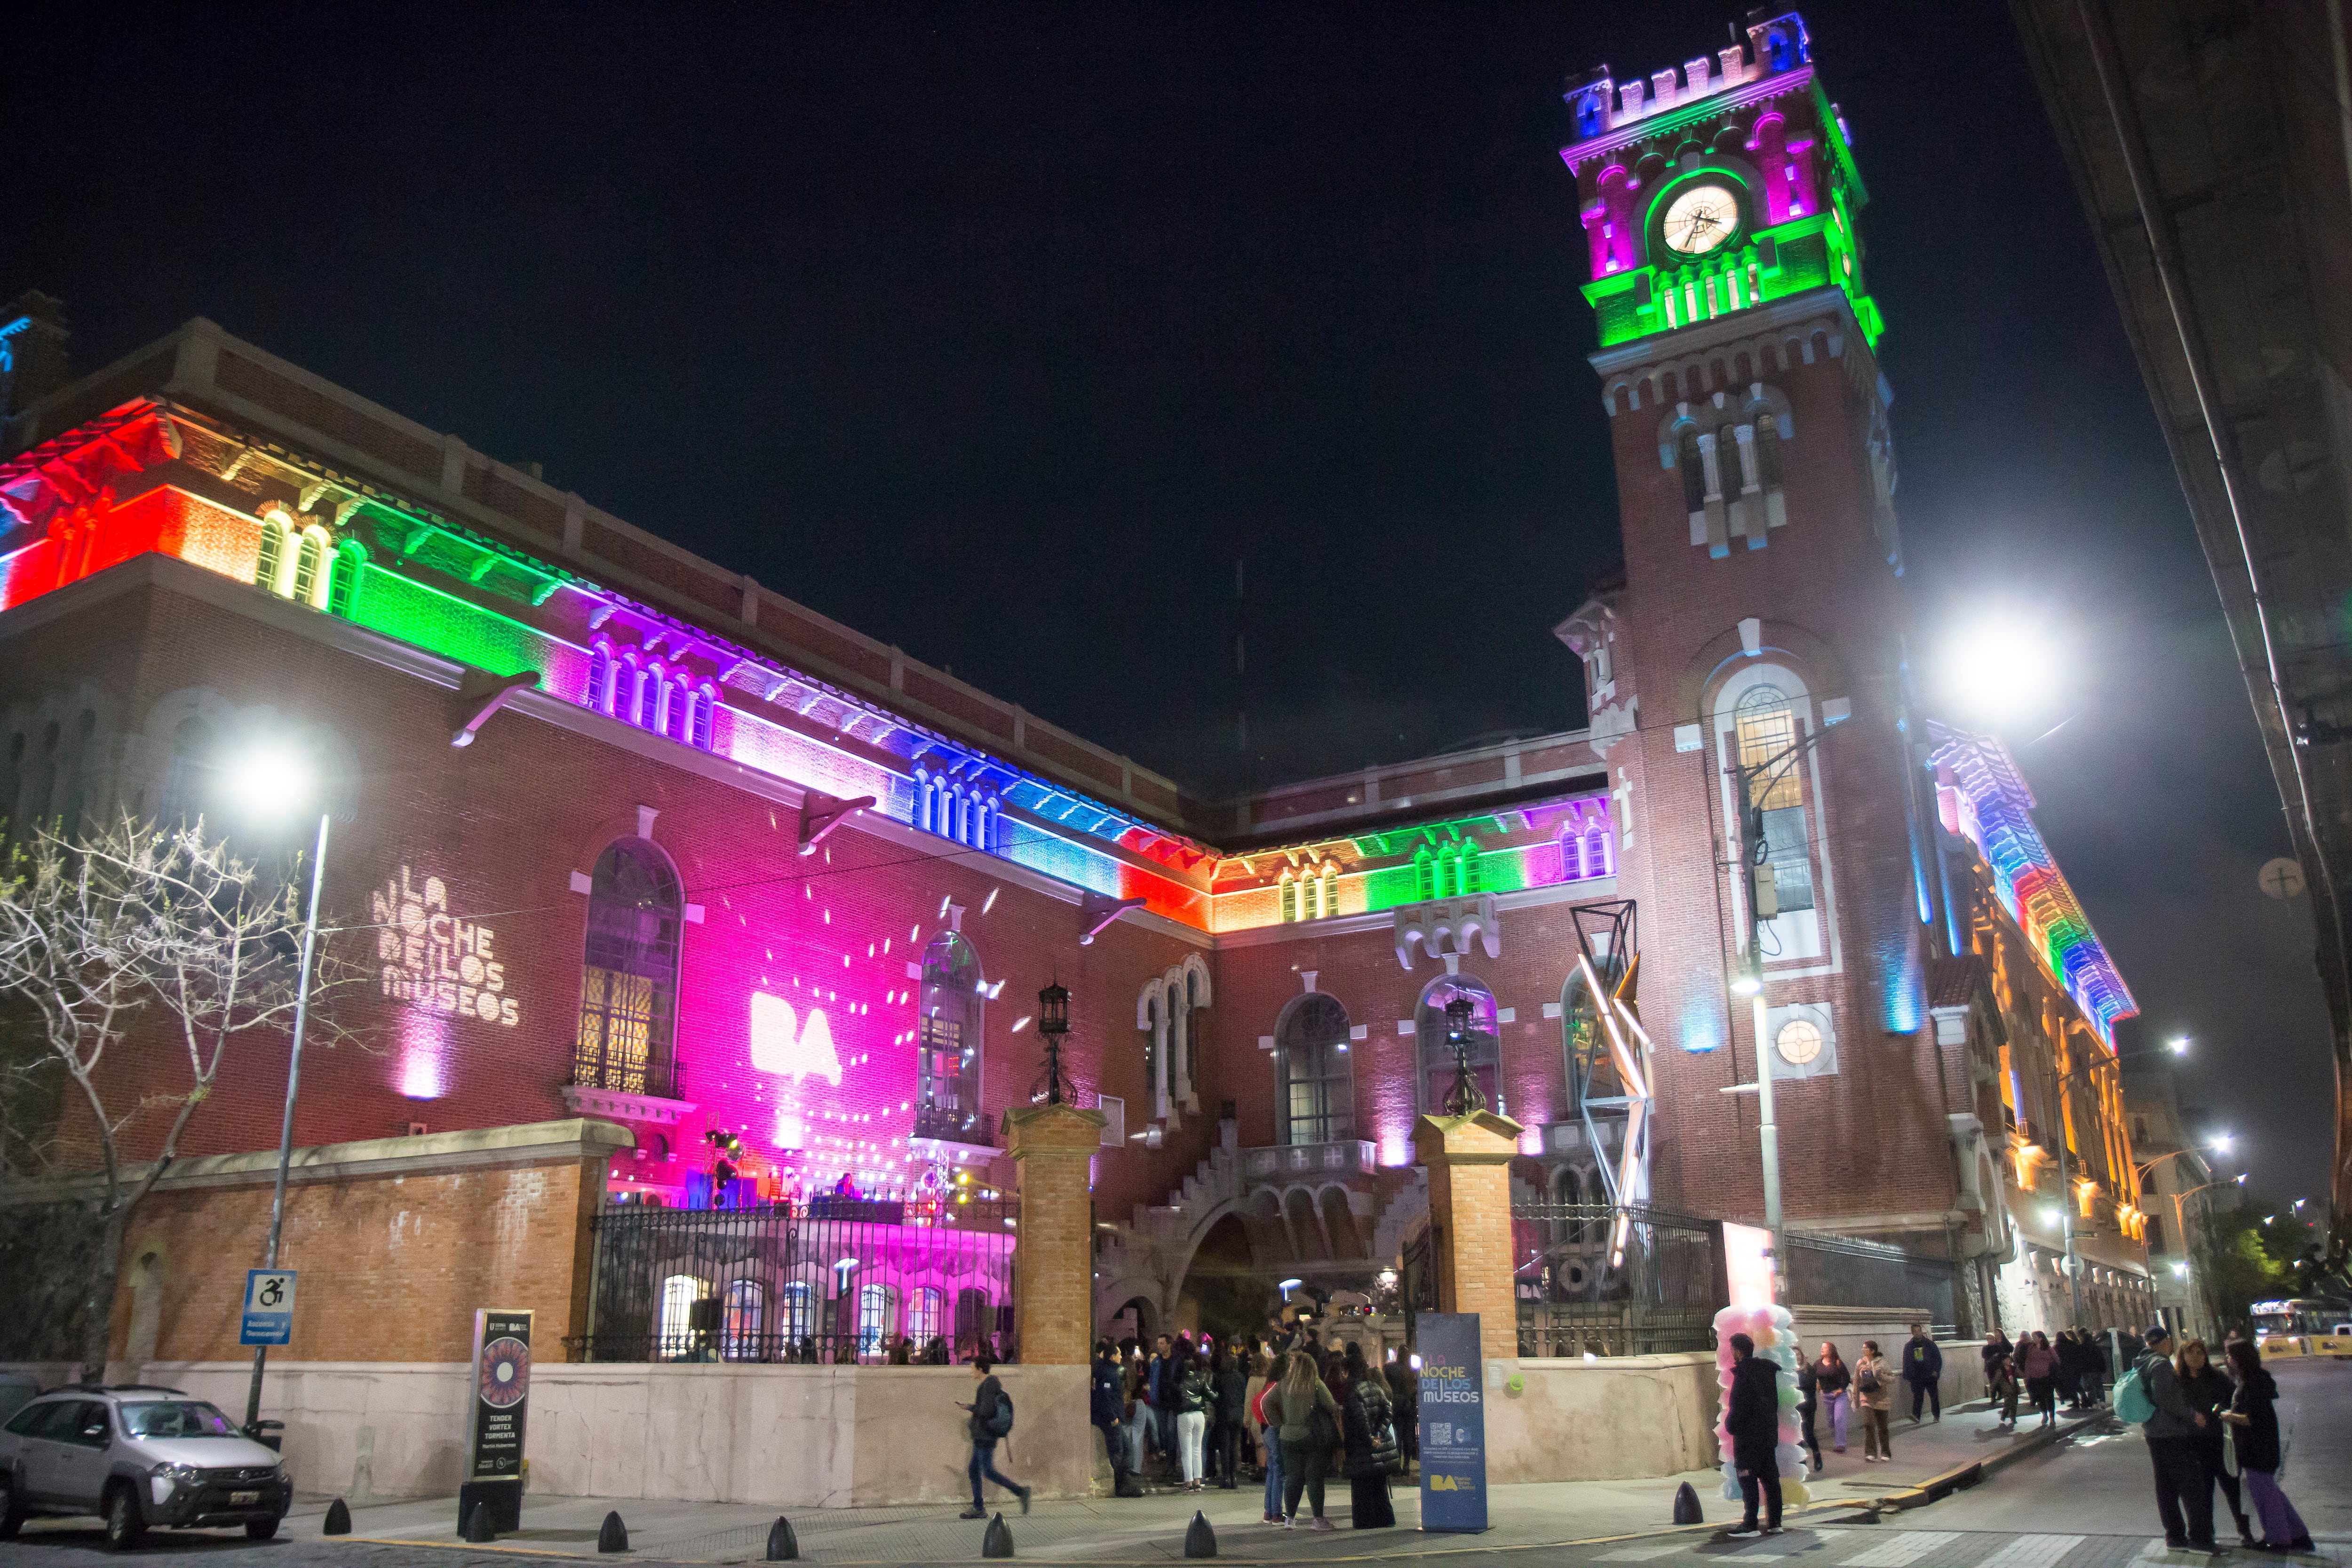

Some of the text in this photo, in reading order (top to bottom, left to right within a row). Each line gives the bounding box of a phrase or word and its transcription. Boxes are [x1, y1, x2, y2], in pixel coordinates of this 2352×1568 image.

[402, 866, 447, 912] LA
[373, 880, 494, 960] NOCHE
[379, 928, 505, 992] DE LOS
[382, 947, 519, 1027] MUSEOS
[750, 991, 842, 1086] BA
[1420, 1361, 1466, 1381] NOCHE
[1422, 1378, 1471, 1390] DE LOS
[1423, 1378, 1479, 1403] MUSEOS
[1430, 1474, 1458, 1491] BA
